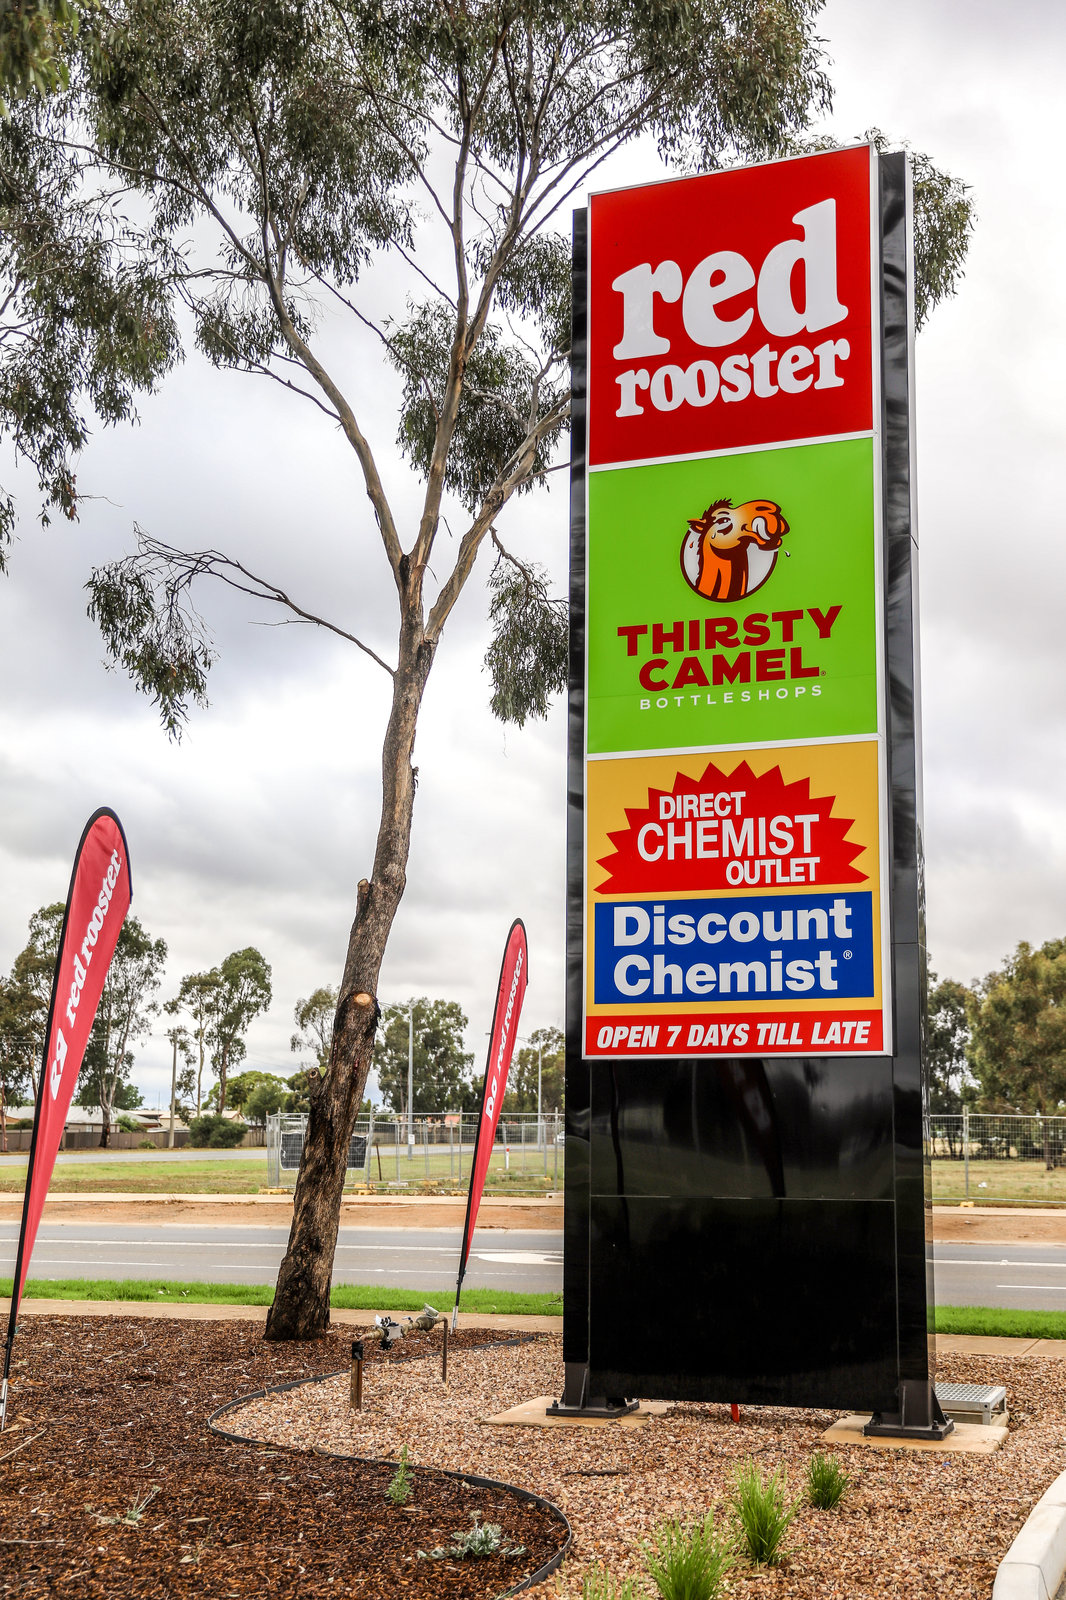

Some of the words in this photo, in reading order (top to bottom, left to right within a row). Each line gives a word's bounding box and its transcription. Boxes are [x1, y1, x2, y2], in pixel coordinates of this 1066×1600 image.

[611, 198, 849, 361] red
[614, 338, 851, 418] rooster
[617, 604, 843, 657] THIRSTY
[638, 645, 820, 692] CAMEL
[639, 684, 822, 710] BOTTLESHOPS
[659, 791, 747, 820] DIRECT
[637, 813, 820, 862] CHEMIST
[725, 856, 821, 886] OUTLET
[66, 953, 88, 1029] red
[80, 848, 122, 967] rooster
[613, 898, 853, 947] Discount
[504, 947, 525, 1034] rooster
[596, 1025, 660, 1049] OPEN
[666, 1025, 683, 1047] 7
[686, 1023, 750, 1047] DAYS
[756, 1022, 803, 1046] TILL
[810, 1020, 872, 1045] LATE
